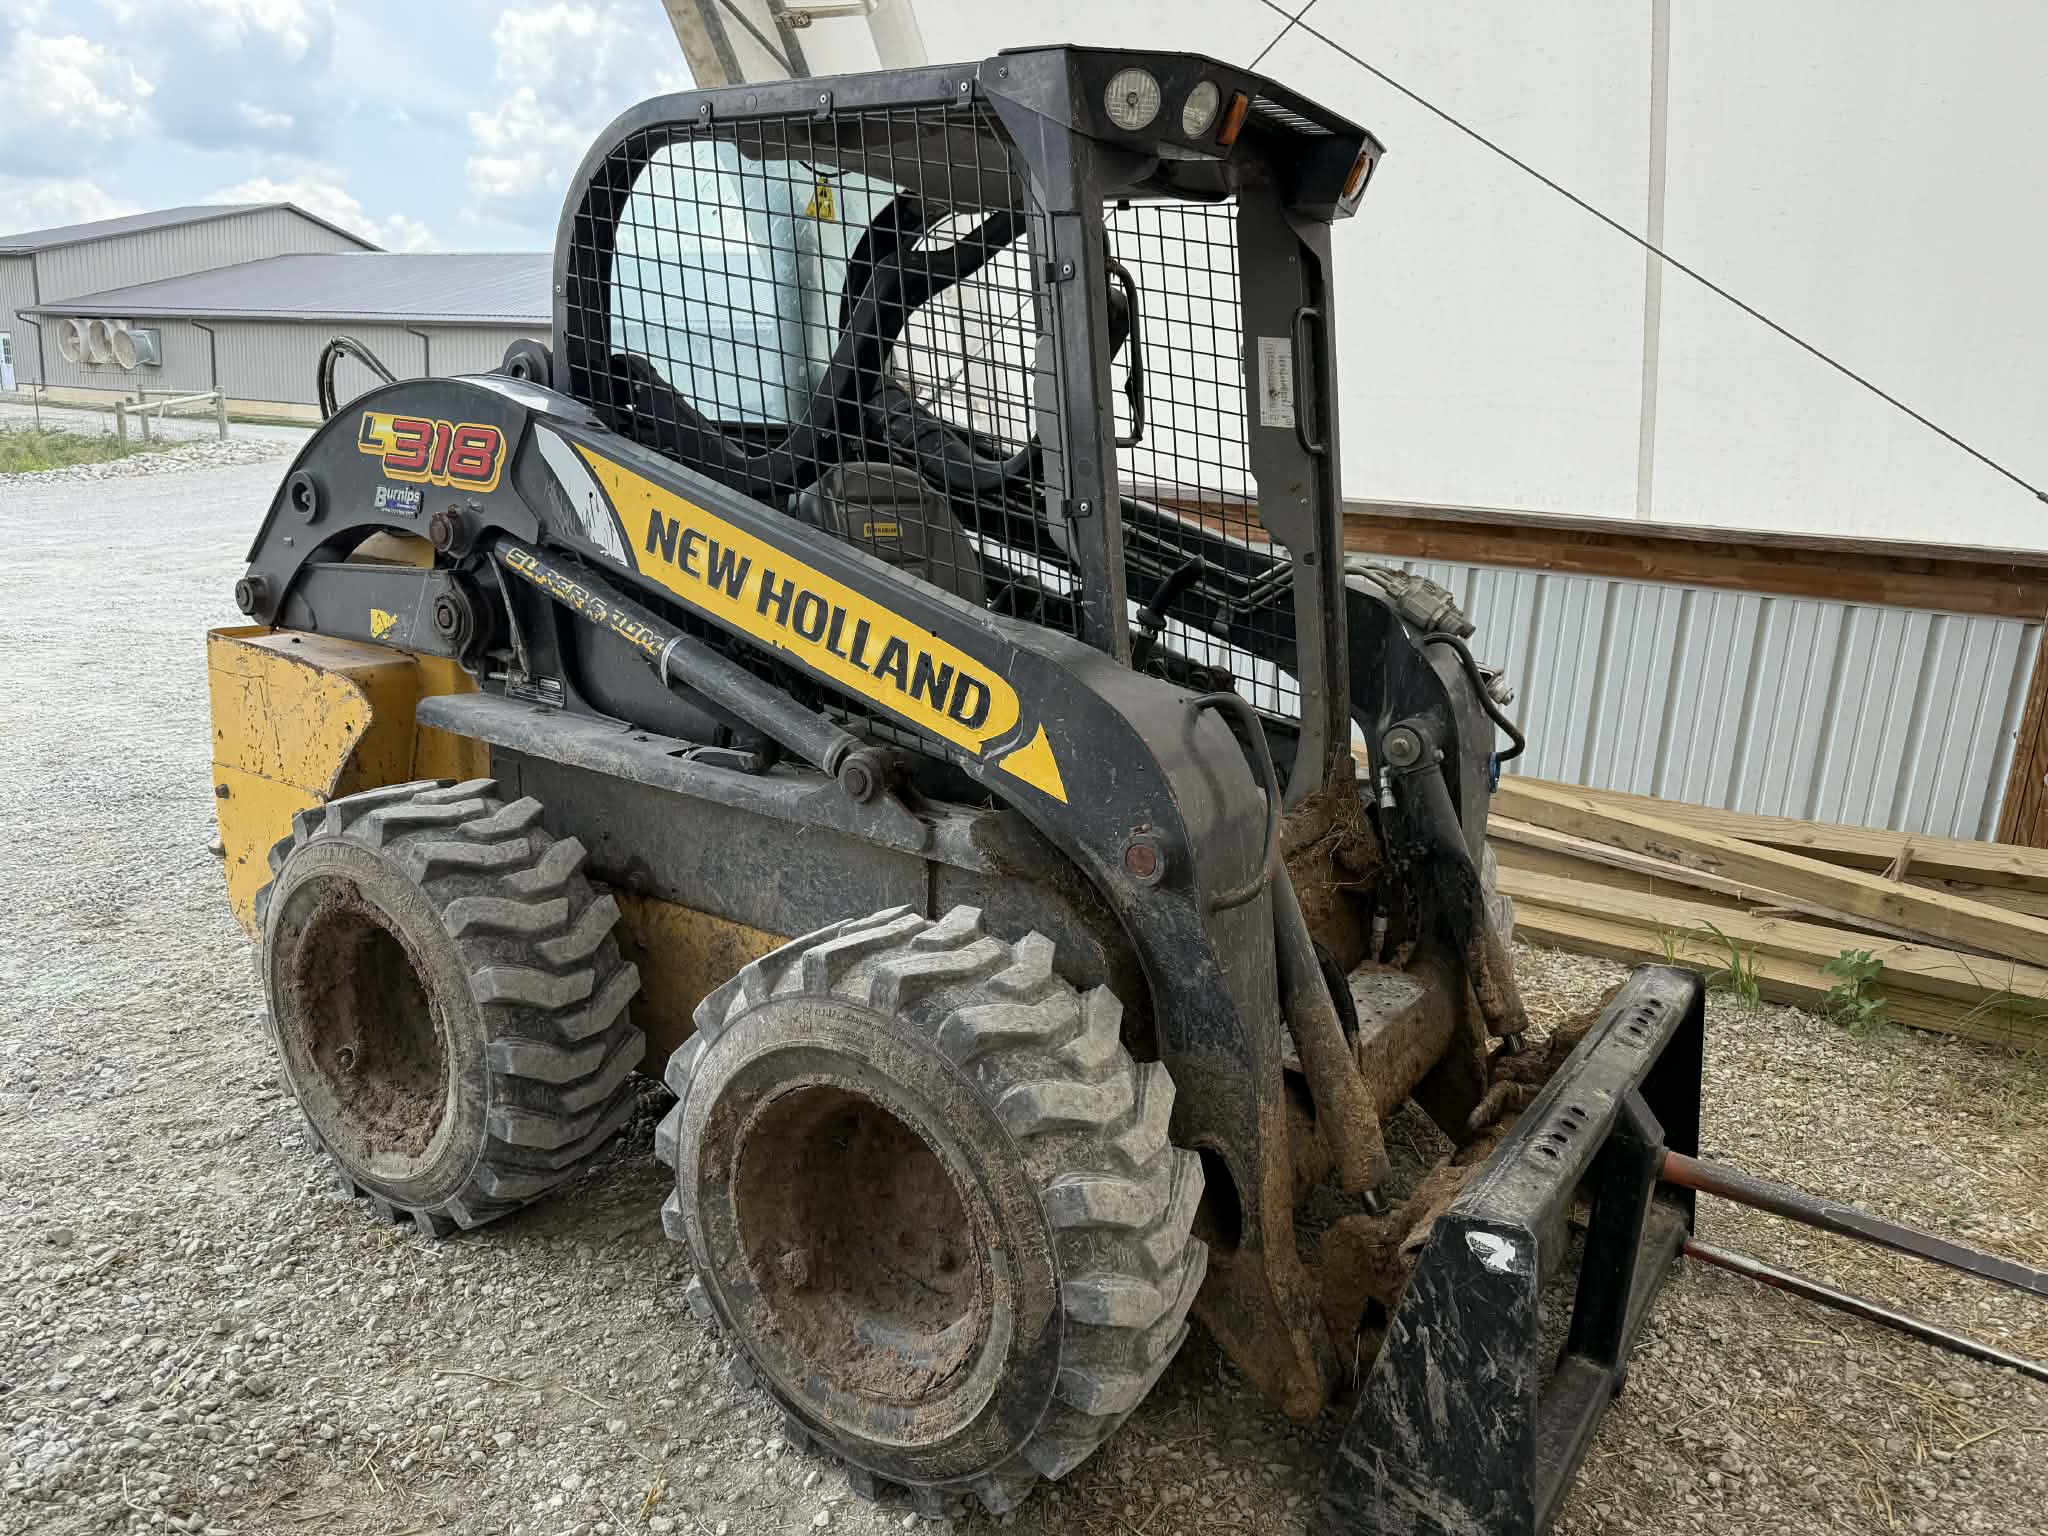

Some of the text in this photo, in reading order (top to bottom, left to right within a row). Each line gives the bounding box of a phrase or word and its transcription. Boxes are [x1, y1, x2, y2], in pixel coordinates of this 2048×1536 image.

[359, 412, 505, 491] L318
[374, 486, 421, 506] Burnips
[645, 507, 992, 732] NEW HOLLAND
